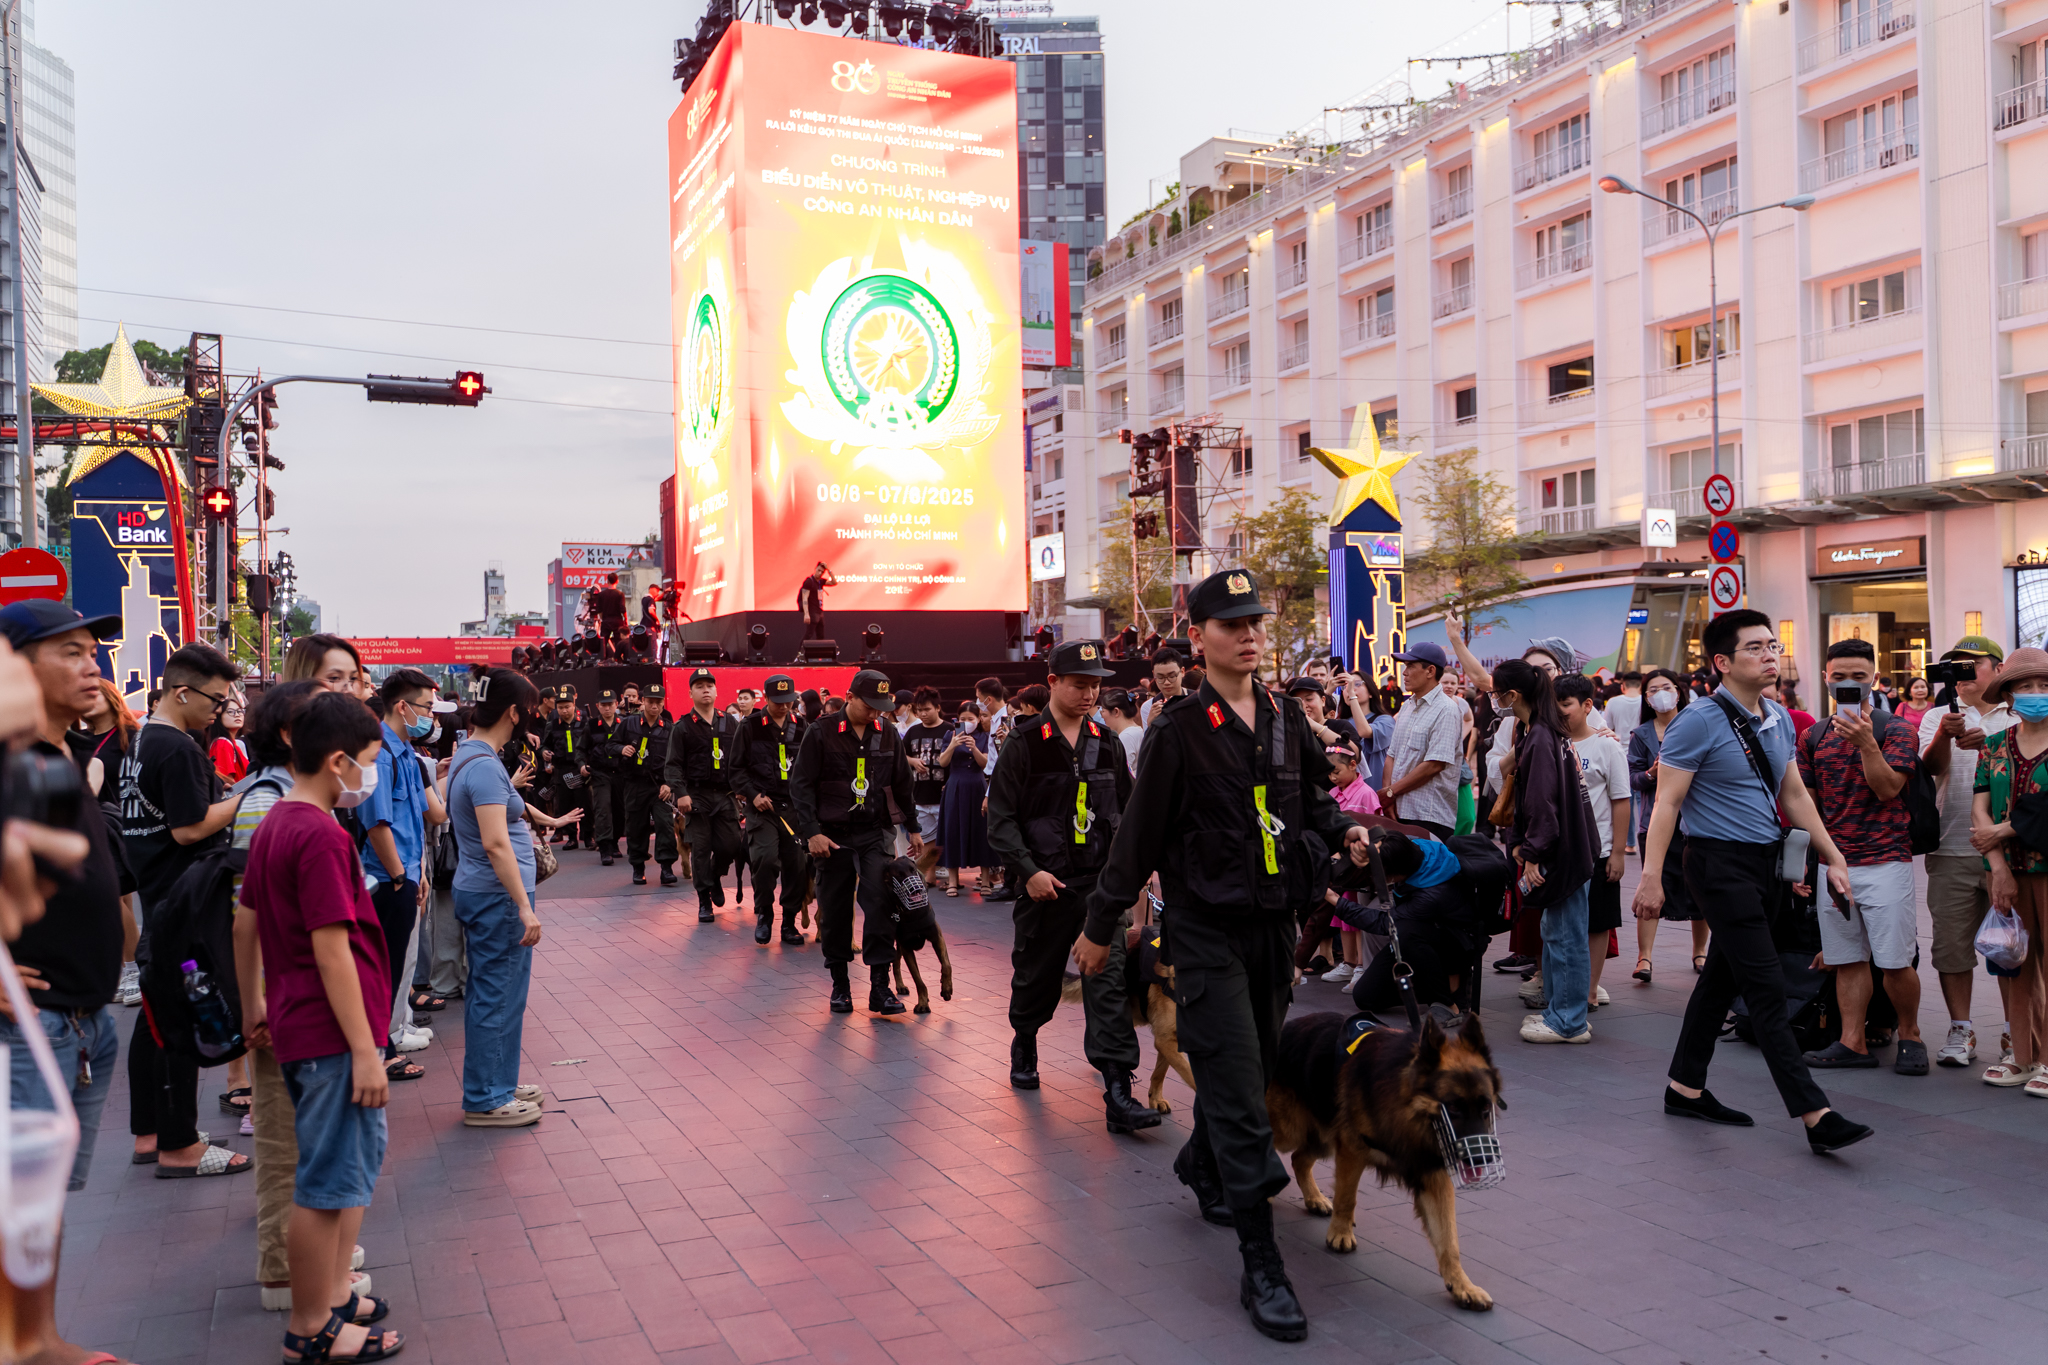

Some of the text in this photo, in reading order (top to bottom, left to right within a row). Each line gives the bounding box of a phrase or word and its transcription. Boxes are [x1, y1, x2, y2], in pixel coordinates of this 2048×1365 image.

[1000, 36, 1044, 54] TRAL
[766, 120, 780, 130] RA
[781, 120, 796, 133] LỜI
[797, 123, 817, 135] KÊU
[818, 127, 835, 138] GỌI
[837, 129, 851, 139] THI
[852, 130, 872, 141] ĐUA
[873, 131, 883, 143] ÁI
[884, 134, 911, 147] QUỐC
[803, 110, 826, 124] NIỆM
[827, 114, 838, 124] 77
[839, 115, 860, 127] NĂM
[861, 118, 886, 131] NGÀY
[887, 120, 907, 133] CHỦ
[908, 124, 928, 137] TỊCH
[929, 125, 943, 138] HỒ
[944, 129, 959, 141] CHÍ
[960, 132, 983, 142] MINH
[831, 153, 946, 179] CHƯƠNG TRÌNH
[761, 167, 1011, 213] BIỂU DIỄN VÕ THUẬT, NGHIỆP VỤ
[803, 196, 974, 228] CÔNG AN NHÂN DÂN
[816, 483, 861, 503] 06/6
[117, 512, 147, 527] HD
[864, 513, 931, 527] ĐẠI LỘ LÊ LỢI
[118, 527, 167, 543] Bank
[836, 527, 958, 541] THÀNH PHỐ HỒ CHÍ MINH
[587, 549, 612, 557] KIM
[565, 575, 581, 586] 09
[582, 575, 597, 586] 77
